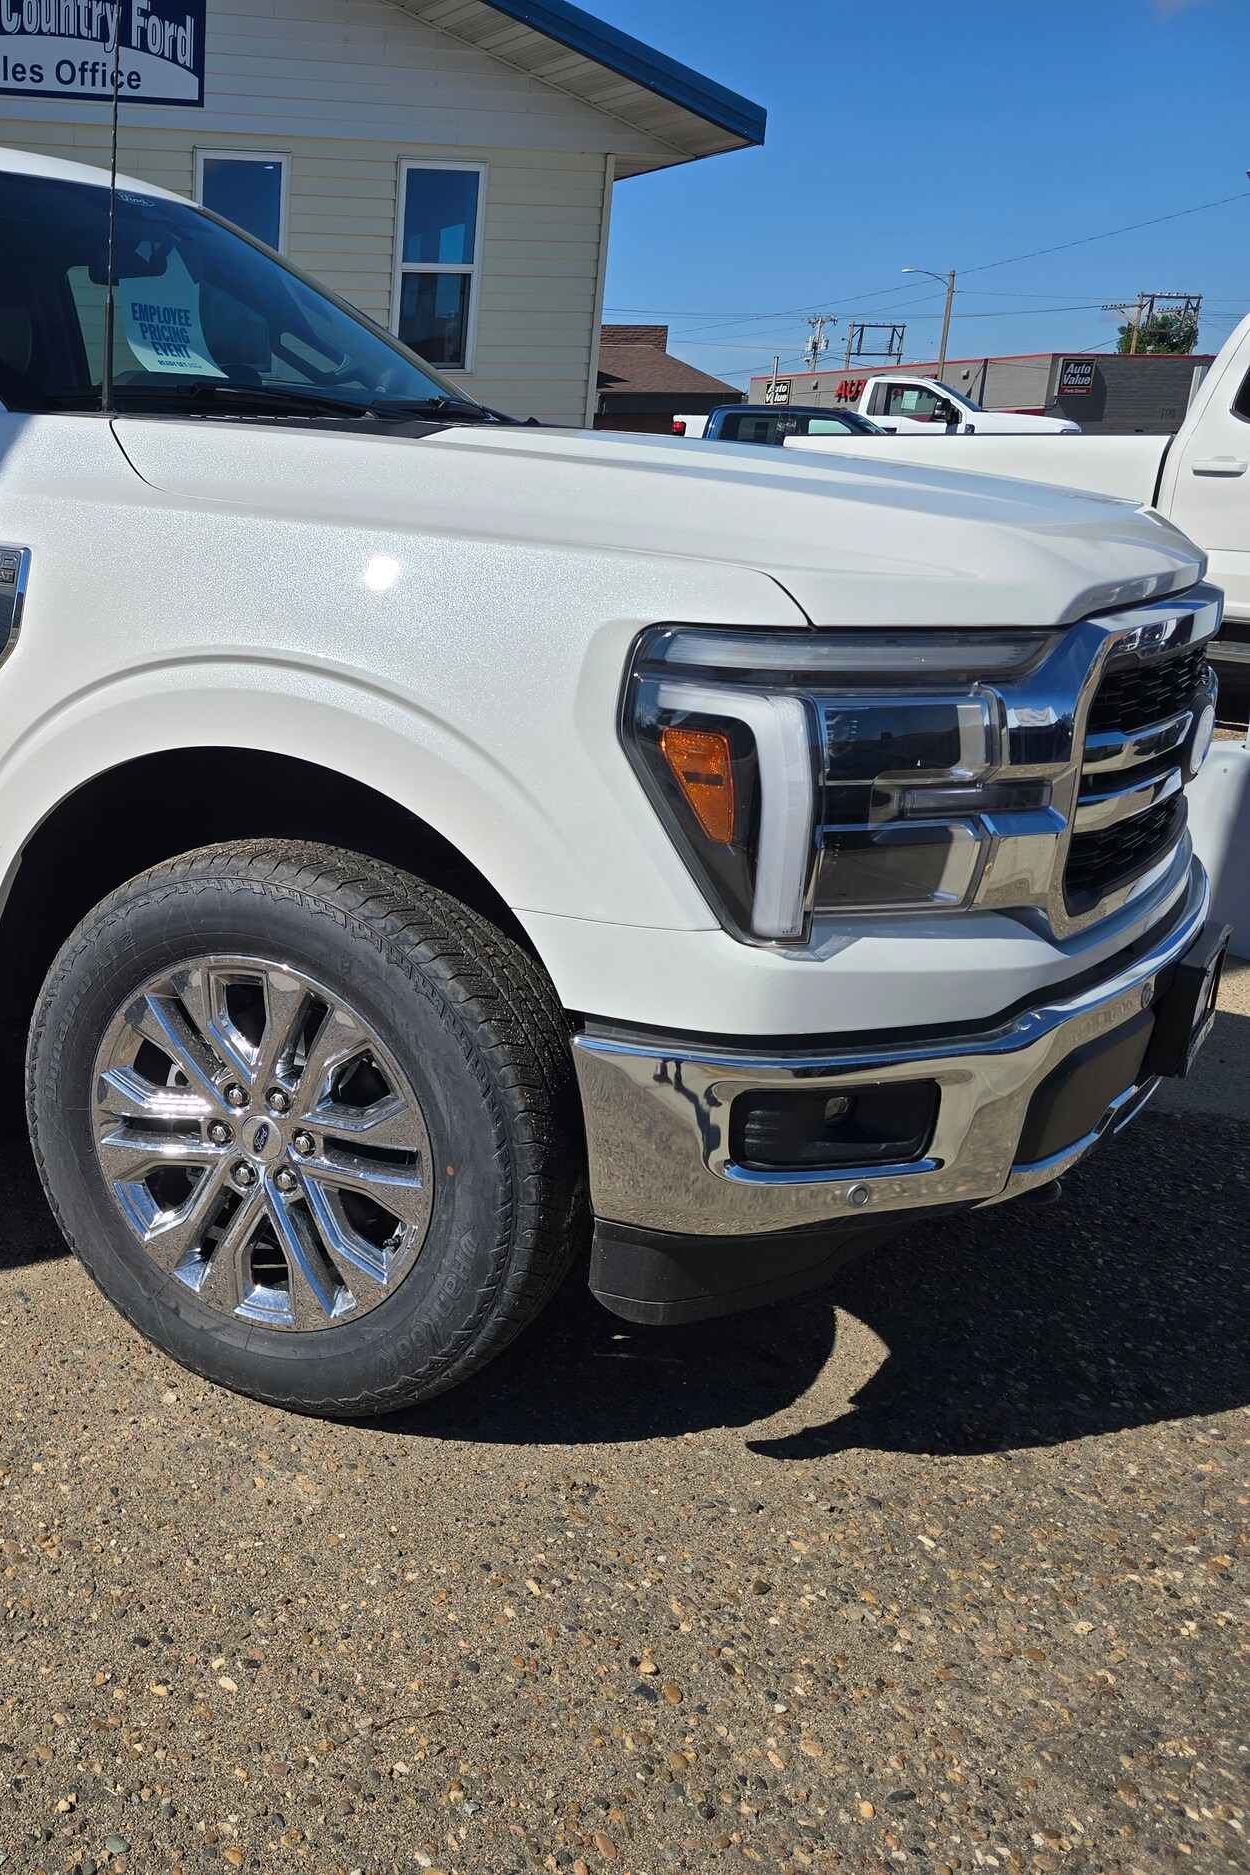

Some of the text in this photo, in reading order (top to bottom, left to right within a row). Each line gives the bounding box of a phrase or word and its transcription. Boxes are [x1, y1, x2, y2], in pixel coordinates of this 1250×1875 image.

[0, 0, 121, 53] Country
[131, 0, 194, 68] Ford
[55, 59, 142, 90] Office
[131, 302, 192, 327] EMPLOYEE
[139, 322, 191, 344] PRICING
[151, 341, 191, 358] EVENT
[1066, 363, 1091, 374] Auto
[835, 379, 870, 398] AUT
[1063, 374, 1090, 385] Value
[765, 393, 787, 403] Vlue
